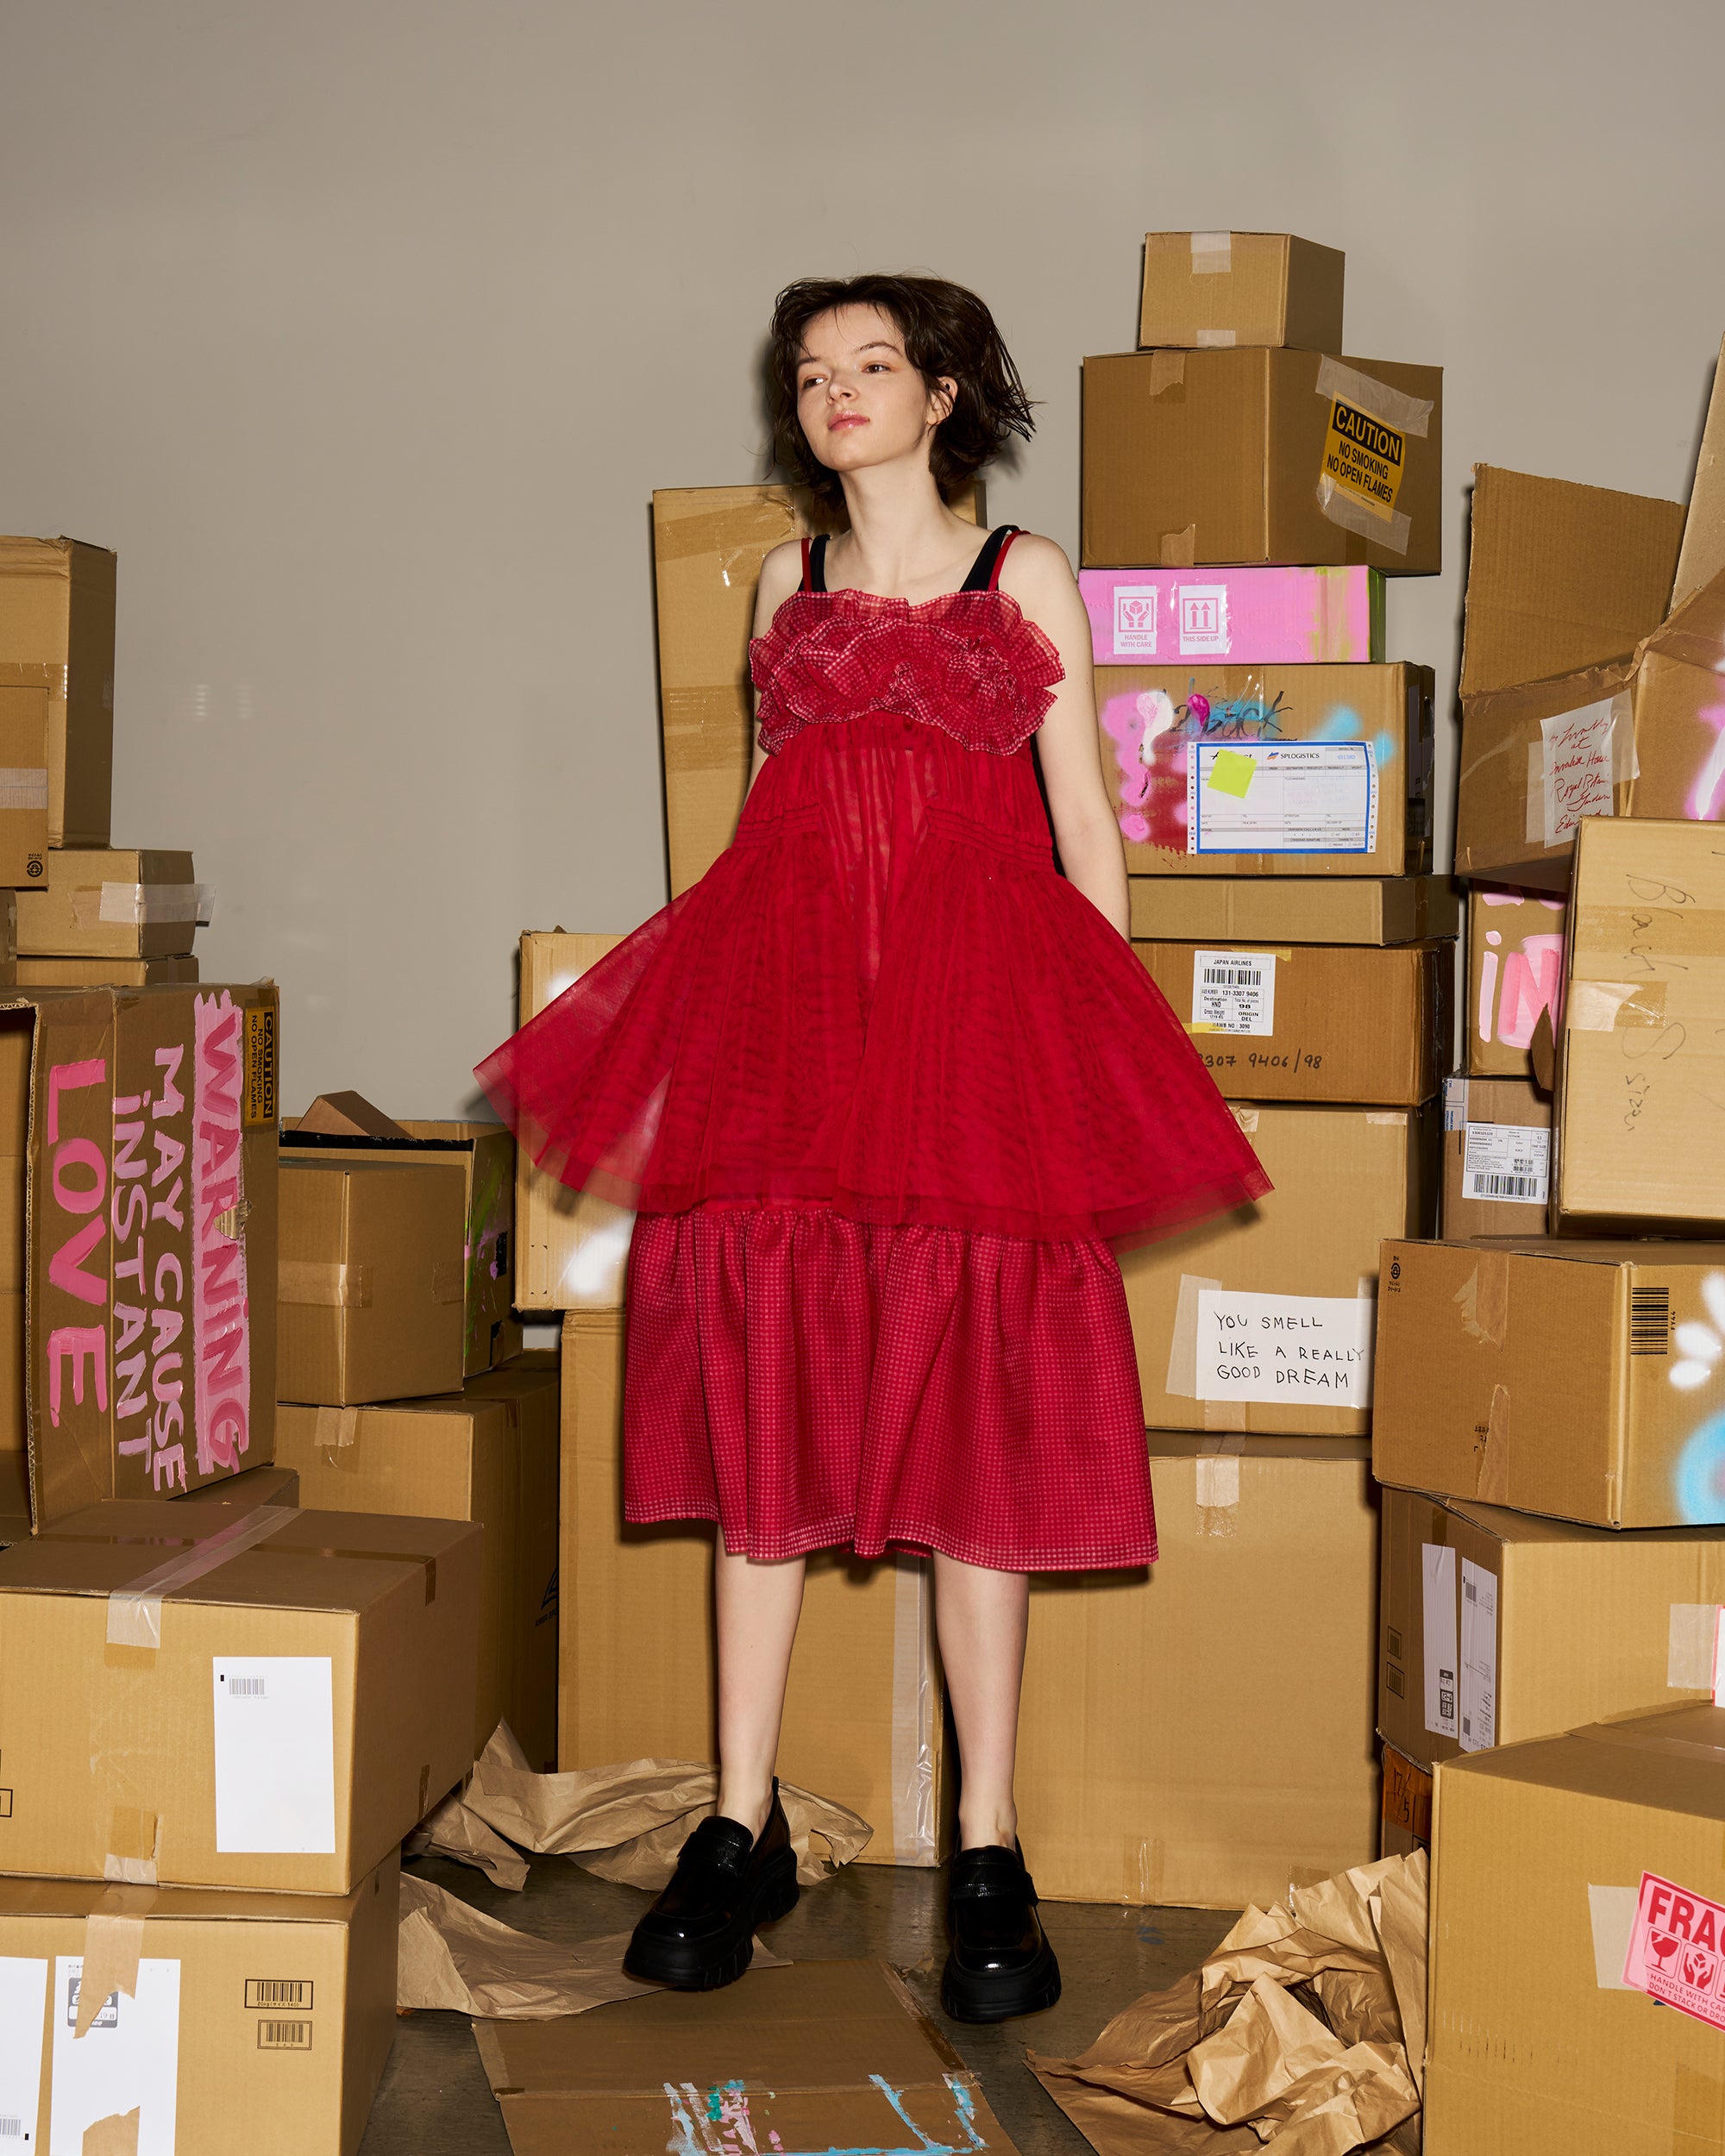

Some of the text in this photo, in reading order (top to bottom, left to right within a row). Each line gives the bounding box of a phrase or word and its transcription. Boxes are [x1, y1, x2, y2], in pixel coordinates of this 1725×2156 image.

[1336, 405, 1400, 461] CAUTION
[1339, 440, 1389, 480] NO SMOKING
[1327, 454, 1339, 473] NO
[1339, 461, 1363, 486] OPEN
[1363, 473, 1393, 503] FLAMES
[252, 1015, 257, 1032] NO
[258, 1028, 263, 1044] NO
[264, 1016, 273, 1114] CAUTION
[1199, 1053, 1237, 1068] 307
[47, 1058, 108, 1427] LOVE
[151, 1044, 187, 1493] MAY CAUSE
[1214, 1311, 1323, 1331] YOU SMELL
[1219, 1341, 1364, 1362] LIKE A REALLY
[1216, 1364, 1348, 1388] GOOD DREAM
[1647, 1885, 1725, 1958] FRA
[1649, 1982, 1672, 1997] DON'T
[1673, 1993, 1696, 2009] STACK
[1697, 2005, 1708, 2014] OR
[1650, 1973, 1684, 1994] HANDLE
[1685, 1990, 1709, 2005] WITH
